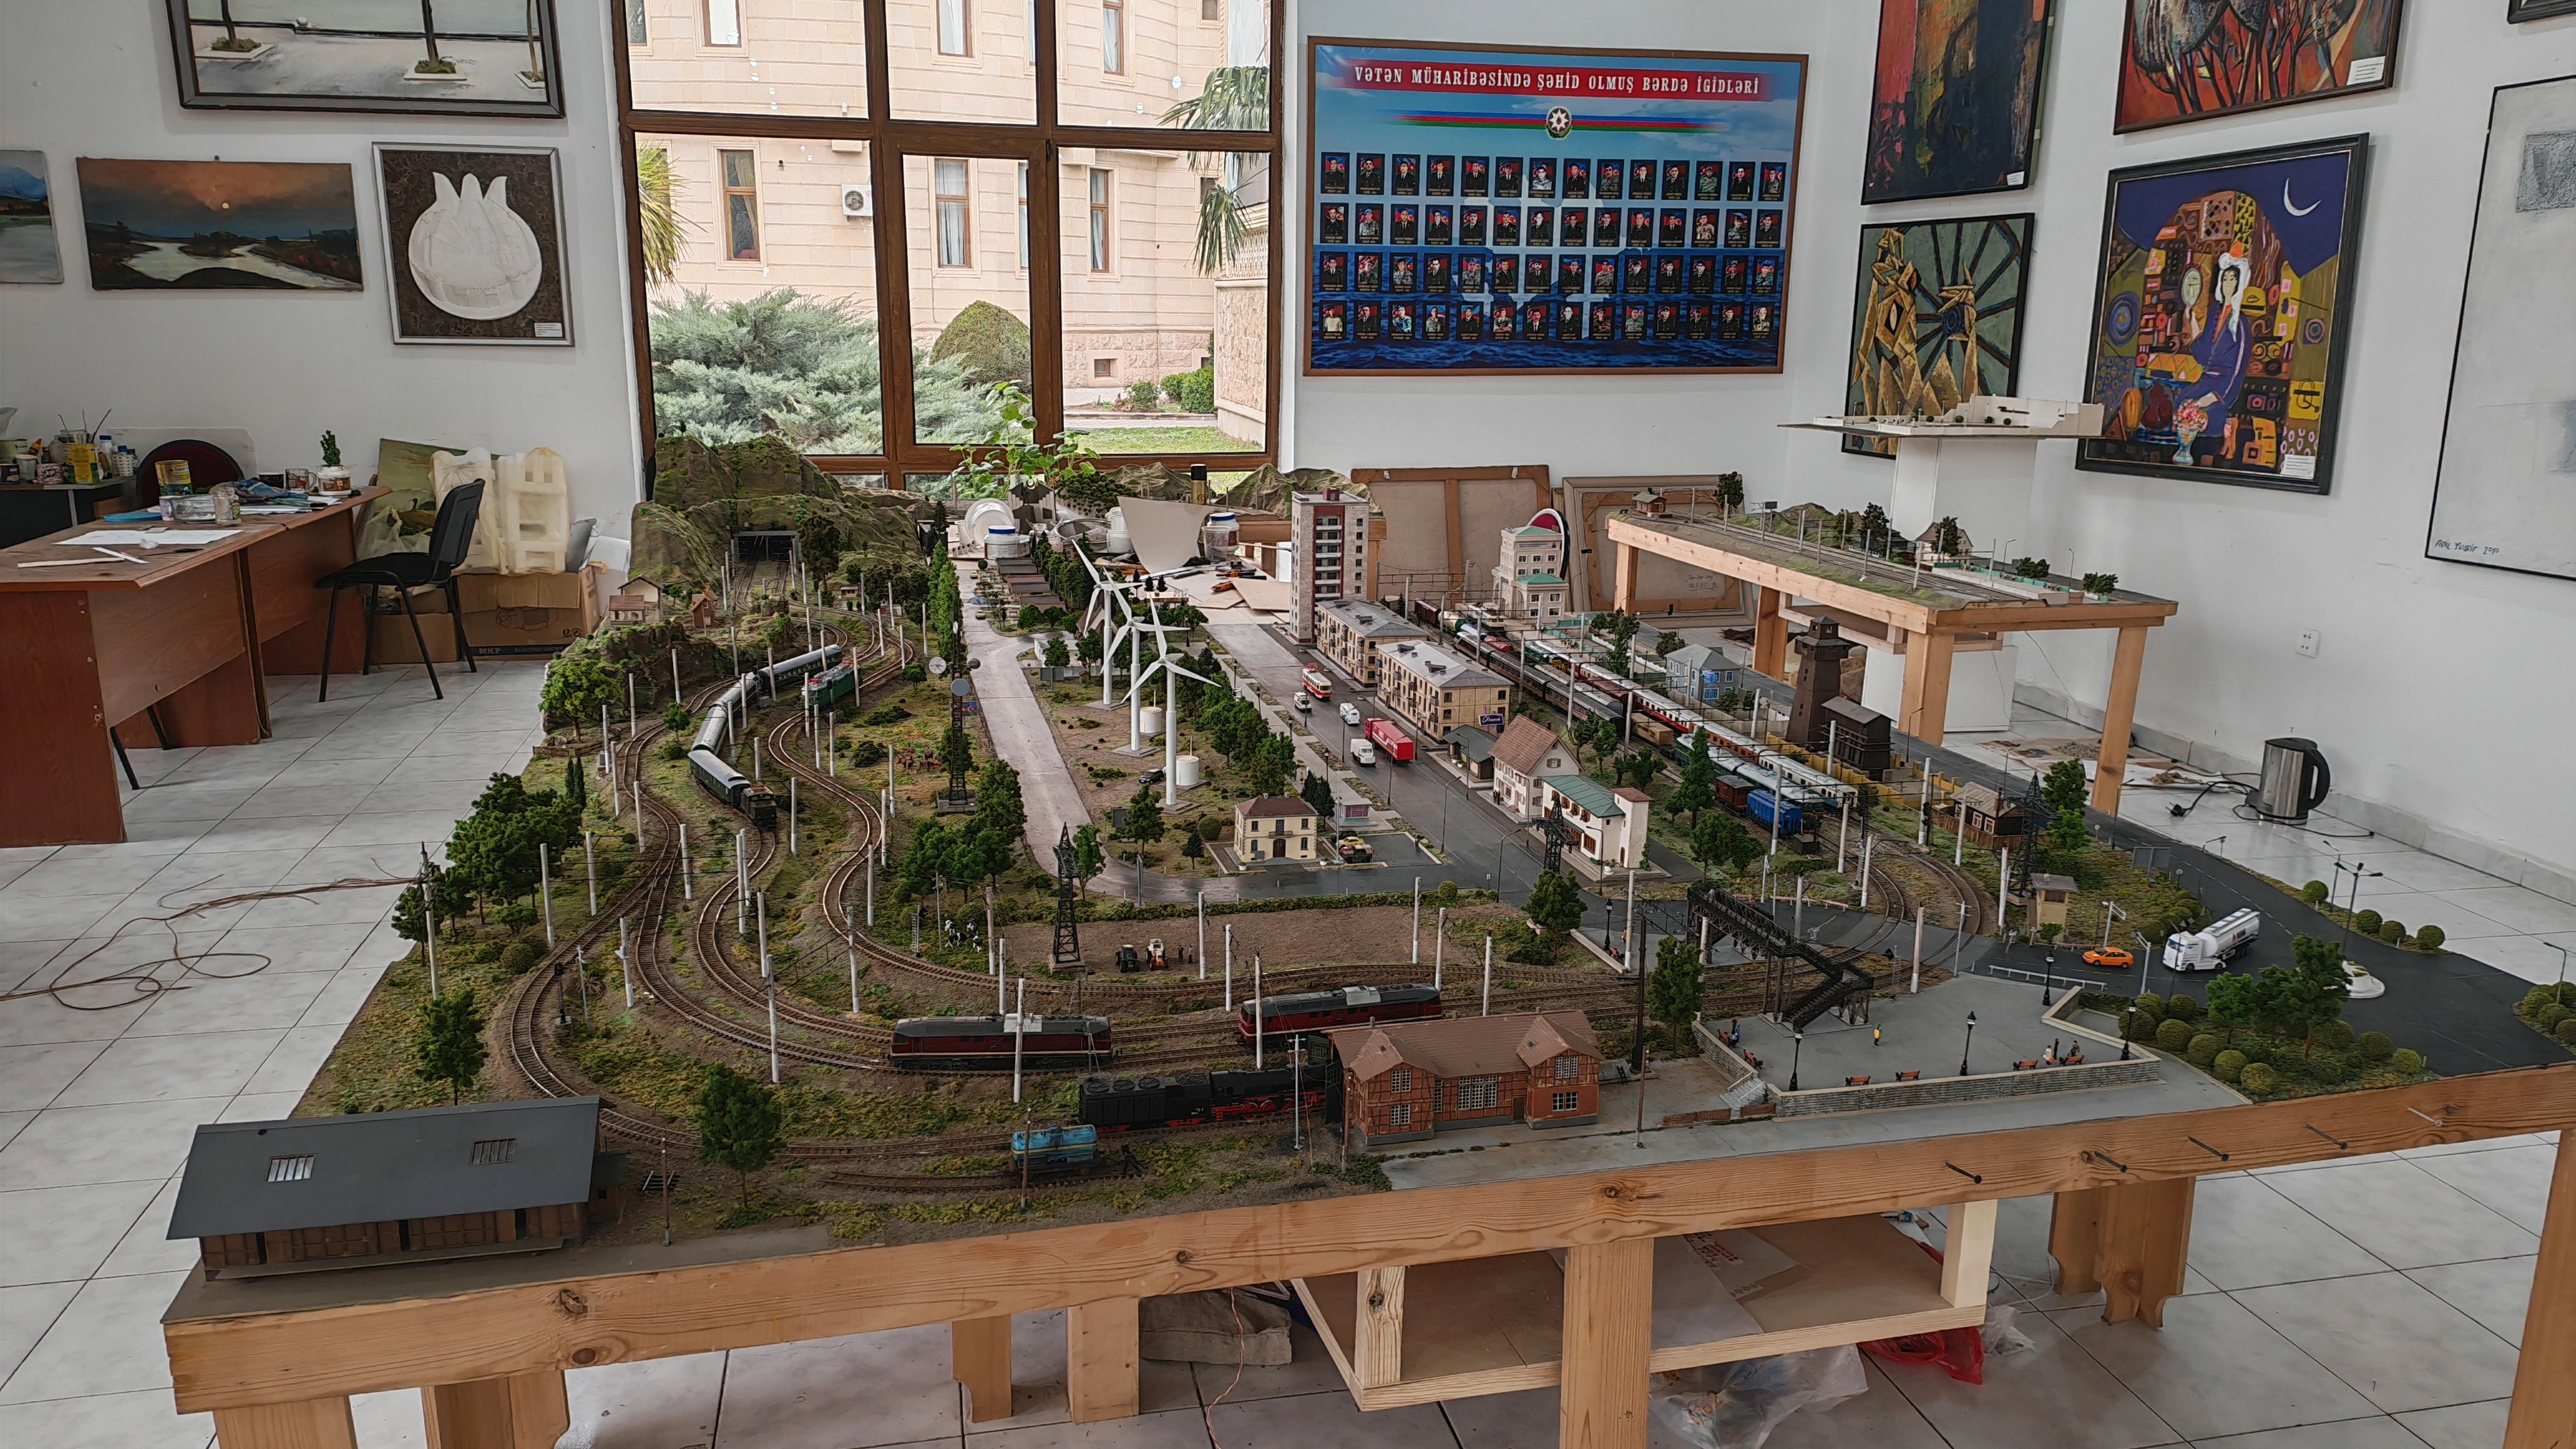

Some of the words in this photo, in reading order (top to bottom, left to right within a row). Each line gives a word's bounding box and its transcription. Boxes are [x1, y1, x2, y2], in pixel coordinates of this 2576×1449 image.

[1355, 67, 1402, 82] VƏTƏN
[1411, 66, 1531, 87] MÜHARİBƏSİNDƏ
[1537, 72, 1579, 91] ŞƏHİD
[1589, 75, 1634, 93] OLMUŞ
[1642, 77, 1688, 92] BƏRDƏ
[1697, 75, 1759, 94] İGİDLƏRİ
